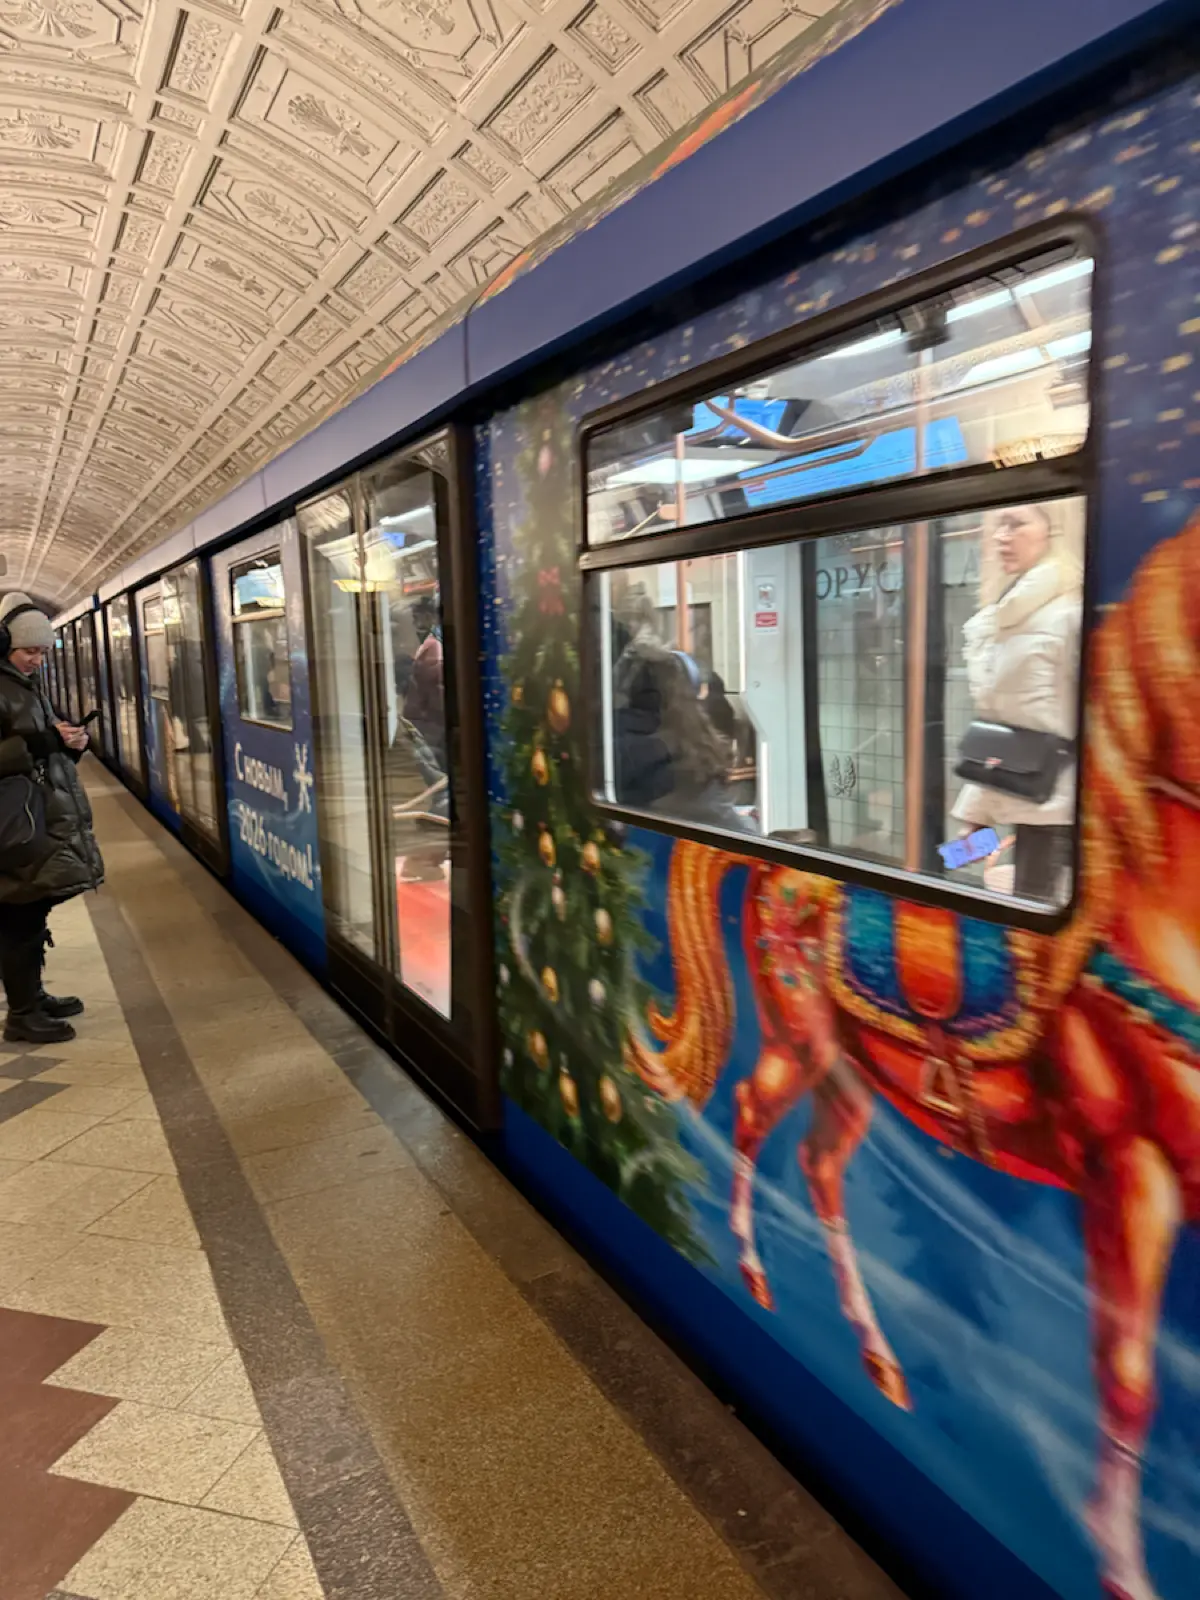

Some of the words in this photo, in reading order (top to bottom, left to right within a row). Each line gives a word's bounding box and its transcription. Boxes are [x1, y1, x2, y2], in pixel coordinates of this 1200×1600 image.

[234, 742, 244, 781] С
[243, 755, 289, 812] новым,
[238, 803, 267, 857] 2026
[267, 831, 315, 892] годом!
